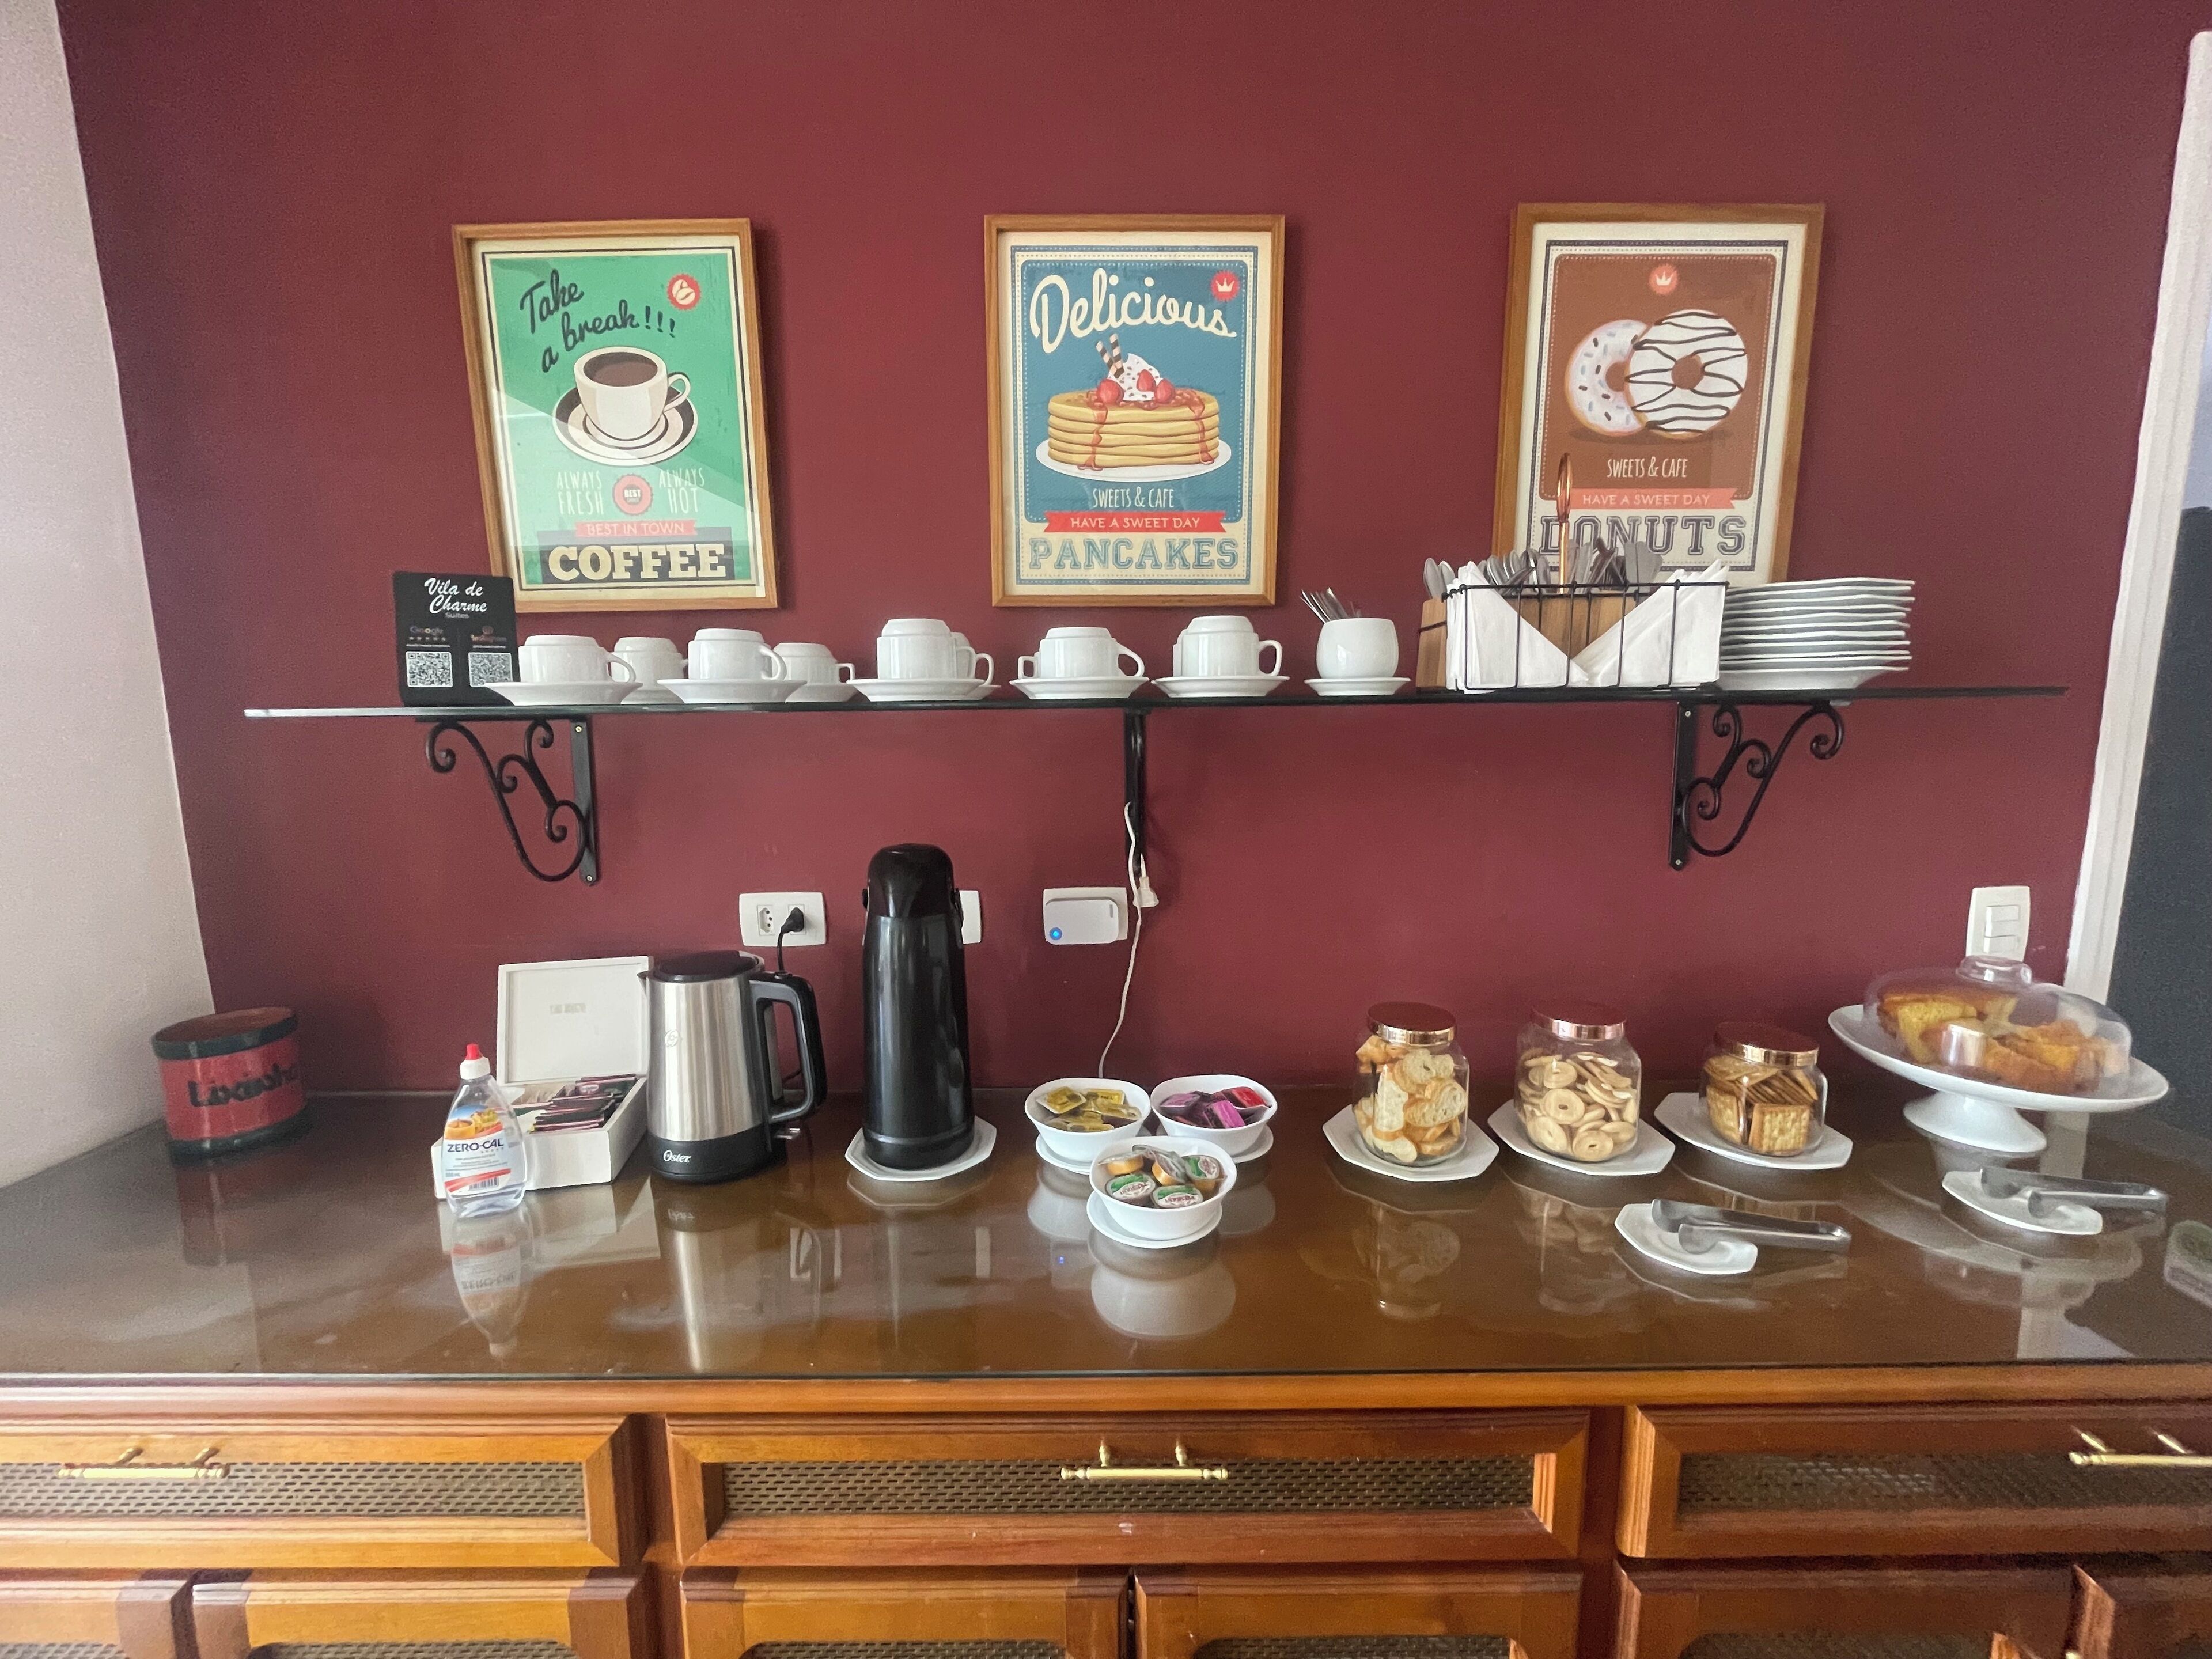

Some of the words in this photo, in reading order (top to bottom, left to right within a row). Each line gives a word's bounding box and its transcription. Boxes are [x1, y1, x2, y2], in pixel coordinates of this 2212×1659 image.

[520, 269, 585, 334] Take
[1029, 267, 1237, 354] Delicious
[541, 346, 559, 373] a
[1607, 458, 1646, 478] SWEETS
[1647, 456, 1658, 477] &
[1662, 457, 1688, 477] CAFE
[556, 471, 602, 489] ALWAYS
[658, 468, 706, 488] ALWAYS
[624, 488, 641, 498] BEST
[667, 488, 699, 514] HOT
[1093, 489, 1131, 507] SWEETS
[1135, 488, 1145, 507] &
[1149, 488, 1175, 507] CAFE
[1583, 494, 1616, 505] HAVE
[1620, 494, 1630, 505] A
[1634, 494, 1680, 505] SWEET
[1683, 494, 1710, 505] DAY
[558, 491, 604, 515] FRESH
[586, 522, 618, 535] BEST
[623, 522, 637, 535] IN
[641, 522, 684, 534] TOWN
[1071, 517, 1107, 528] HAVE
[1109, 517, 1119, 528] A
[1123, 517, 1169, 528] SWEET
[1172, 517, 1199, 529] DAY
[548, 543, 726, 581] COFFEE
[1029, 537, 1237, 570] PANCAKES
[425, 578, 459, 595] Vila
[465, 581, 483, 596] de
[430, 594, 487, 613] Charme
[447, 1139, 504, 1152] ZERO-CAL
[663, 1150, 691, 1162] Oster
